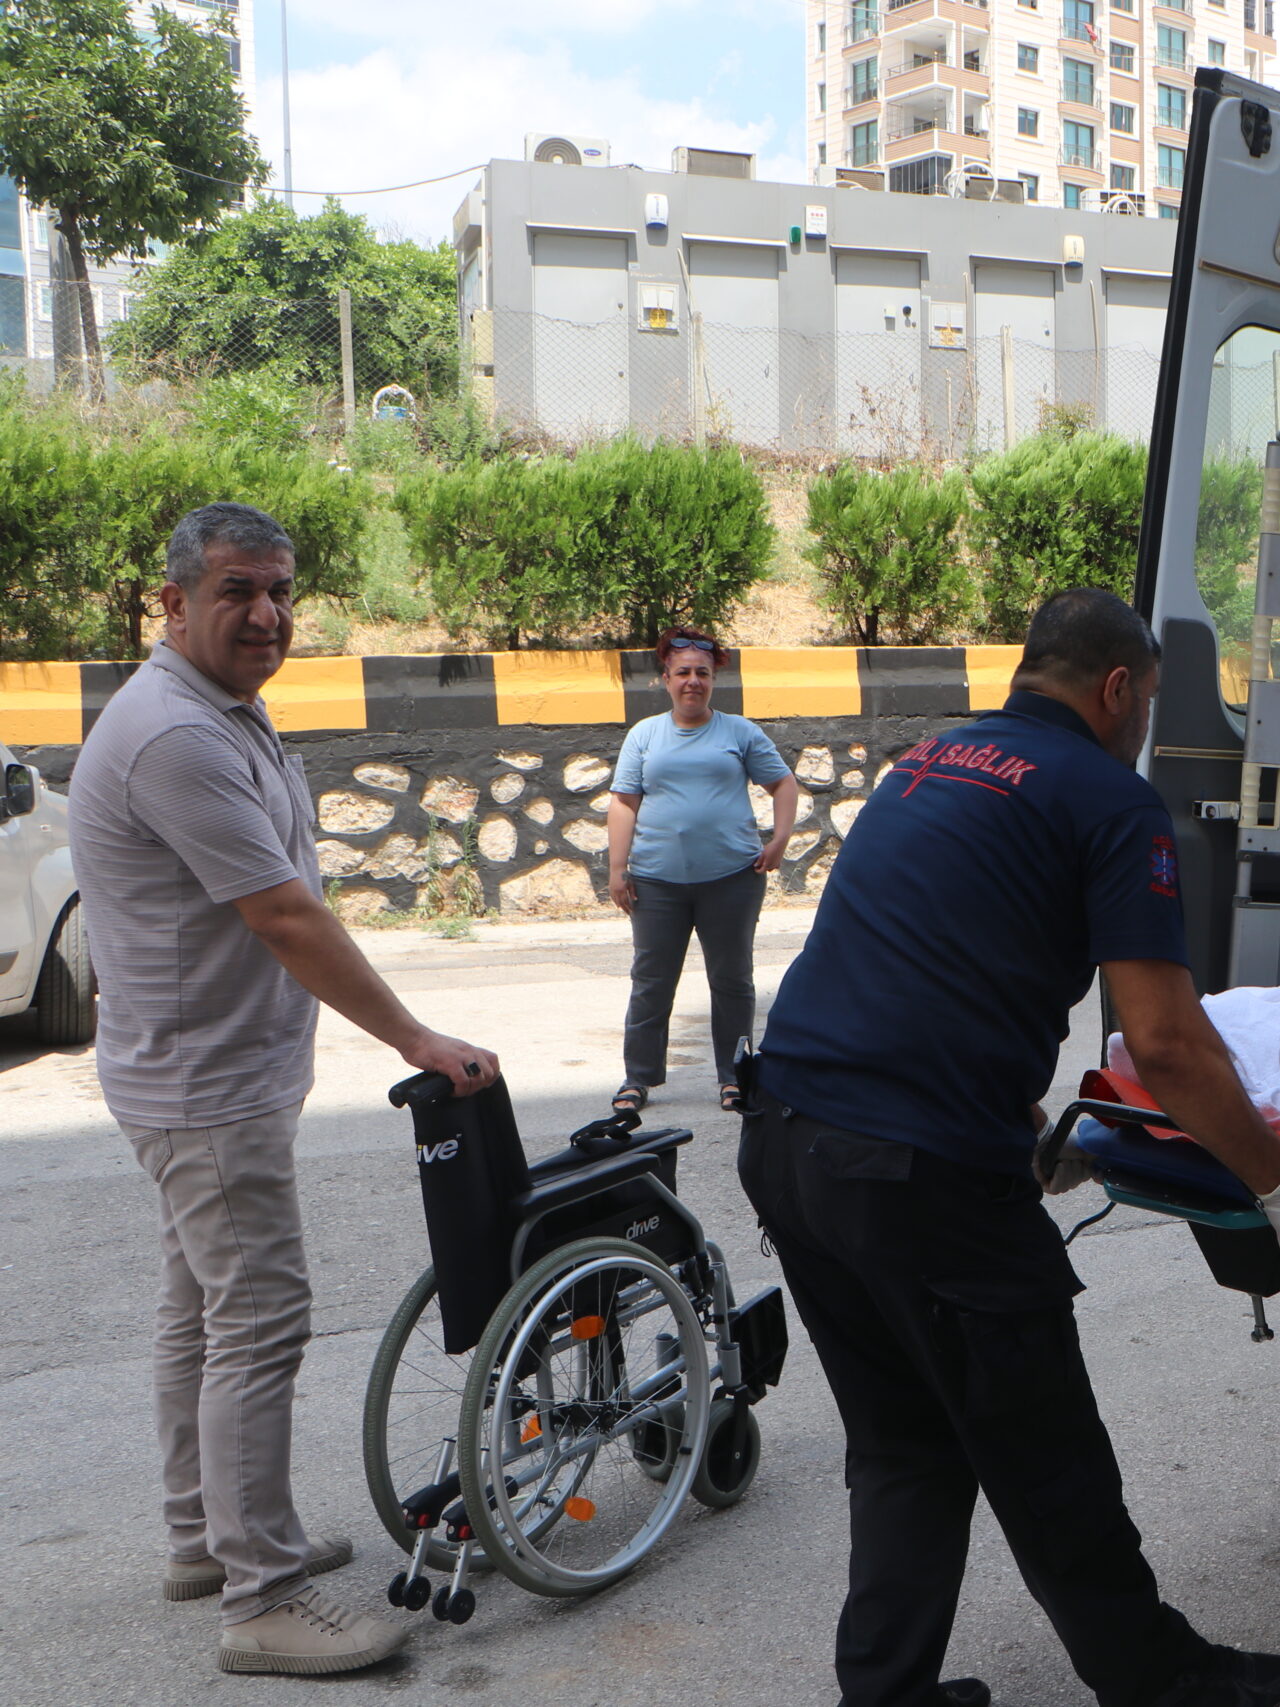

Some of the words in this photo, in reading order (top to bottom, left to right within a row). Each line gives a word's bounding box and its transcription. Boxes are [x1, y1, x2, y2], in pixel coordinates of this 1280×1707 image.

[938, 743, 1040, 786] SAĞLIK
[416, 1138, 460, 1164] ive
[625, 1215, 661, 1241] drive
